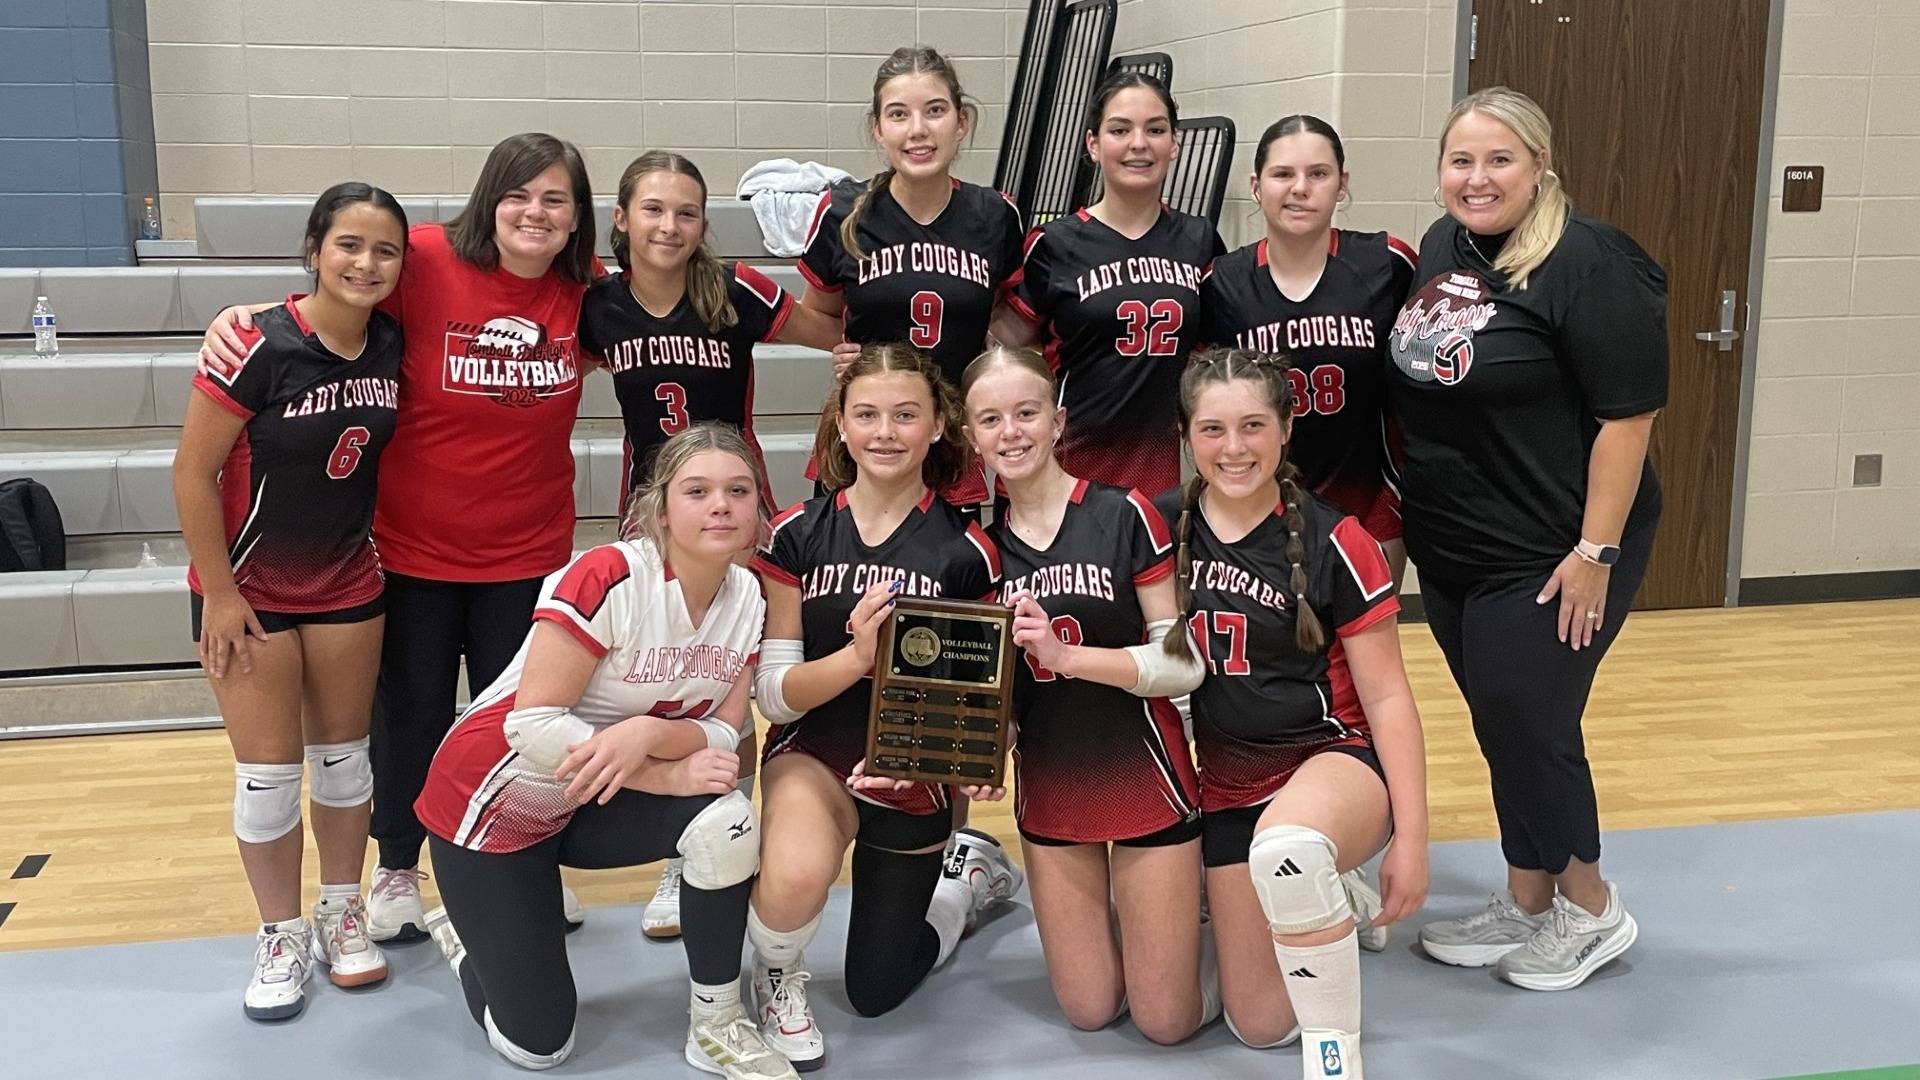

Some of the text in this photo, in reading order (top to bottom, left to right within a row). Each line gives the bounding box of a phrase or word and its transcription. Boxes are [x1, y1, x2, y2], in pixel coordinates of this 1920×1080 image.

[1787, 171, 1814, 180] 1601A
[859, 242, 989, 289] LADY COUGARS
[1077, 257, 1201, 303] LADY COUGARS
[910, 290, 944, 349] 9
[1115, 298, 1183, 357] 32
[1286, 315, 1375, 349] COUGARS
[1419, 298, 1498, 348] Cougars
[459, 338, 515, 358] Tomball
[648, 335, 731, 369] COUGARS
[449, 355, 576, 387] VOLLEYBALL
[282, 382, 340, 418] LADY
[502, 389, 538, 404] 2025
[654, 382, 691, 437] 3
[326, 426, 371, 479] 6
[1031, 562, 1115, 602] COUGARS
[941, 638, 993, 650] VOLLEYBALL
[942, 651, 990, 662] CHAMPIONS
[1188, 610, 1251, 676] 17
[623, 646, 681, 684] LADY
[1574, 934, 1603, 965] HOKA
